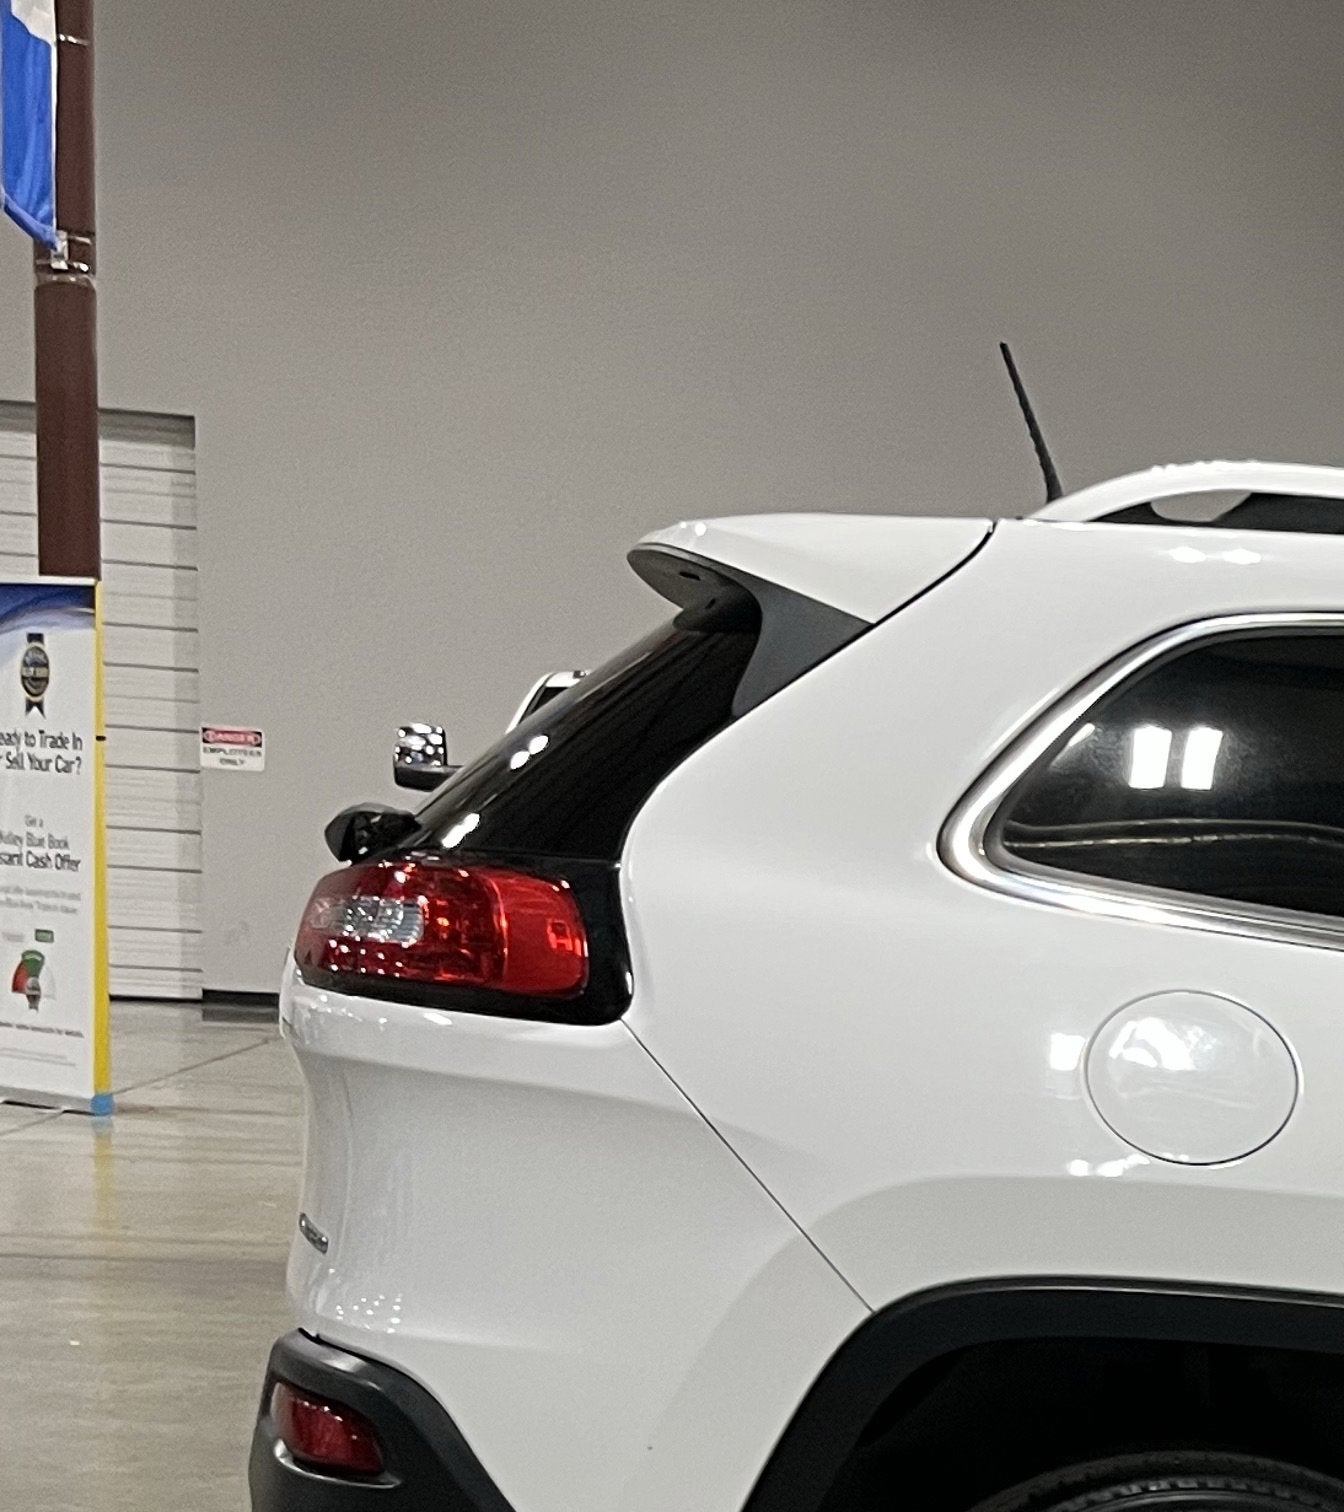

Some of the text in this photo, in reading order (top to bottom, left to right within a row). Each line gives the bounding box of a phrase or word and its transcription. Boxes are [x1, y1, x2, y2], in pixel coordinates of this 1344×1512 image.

[24, 731, 36, 748] to
[39, 729, 70, 750] Trade
[5, 751, 82, 775] Sell Your Car?
[47, 832, 69, 849] Book
[26, 850, 53, 869] Cash
[54, 853, 81, 872] Offer
